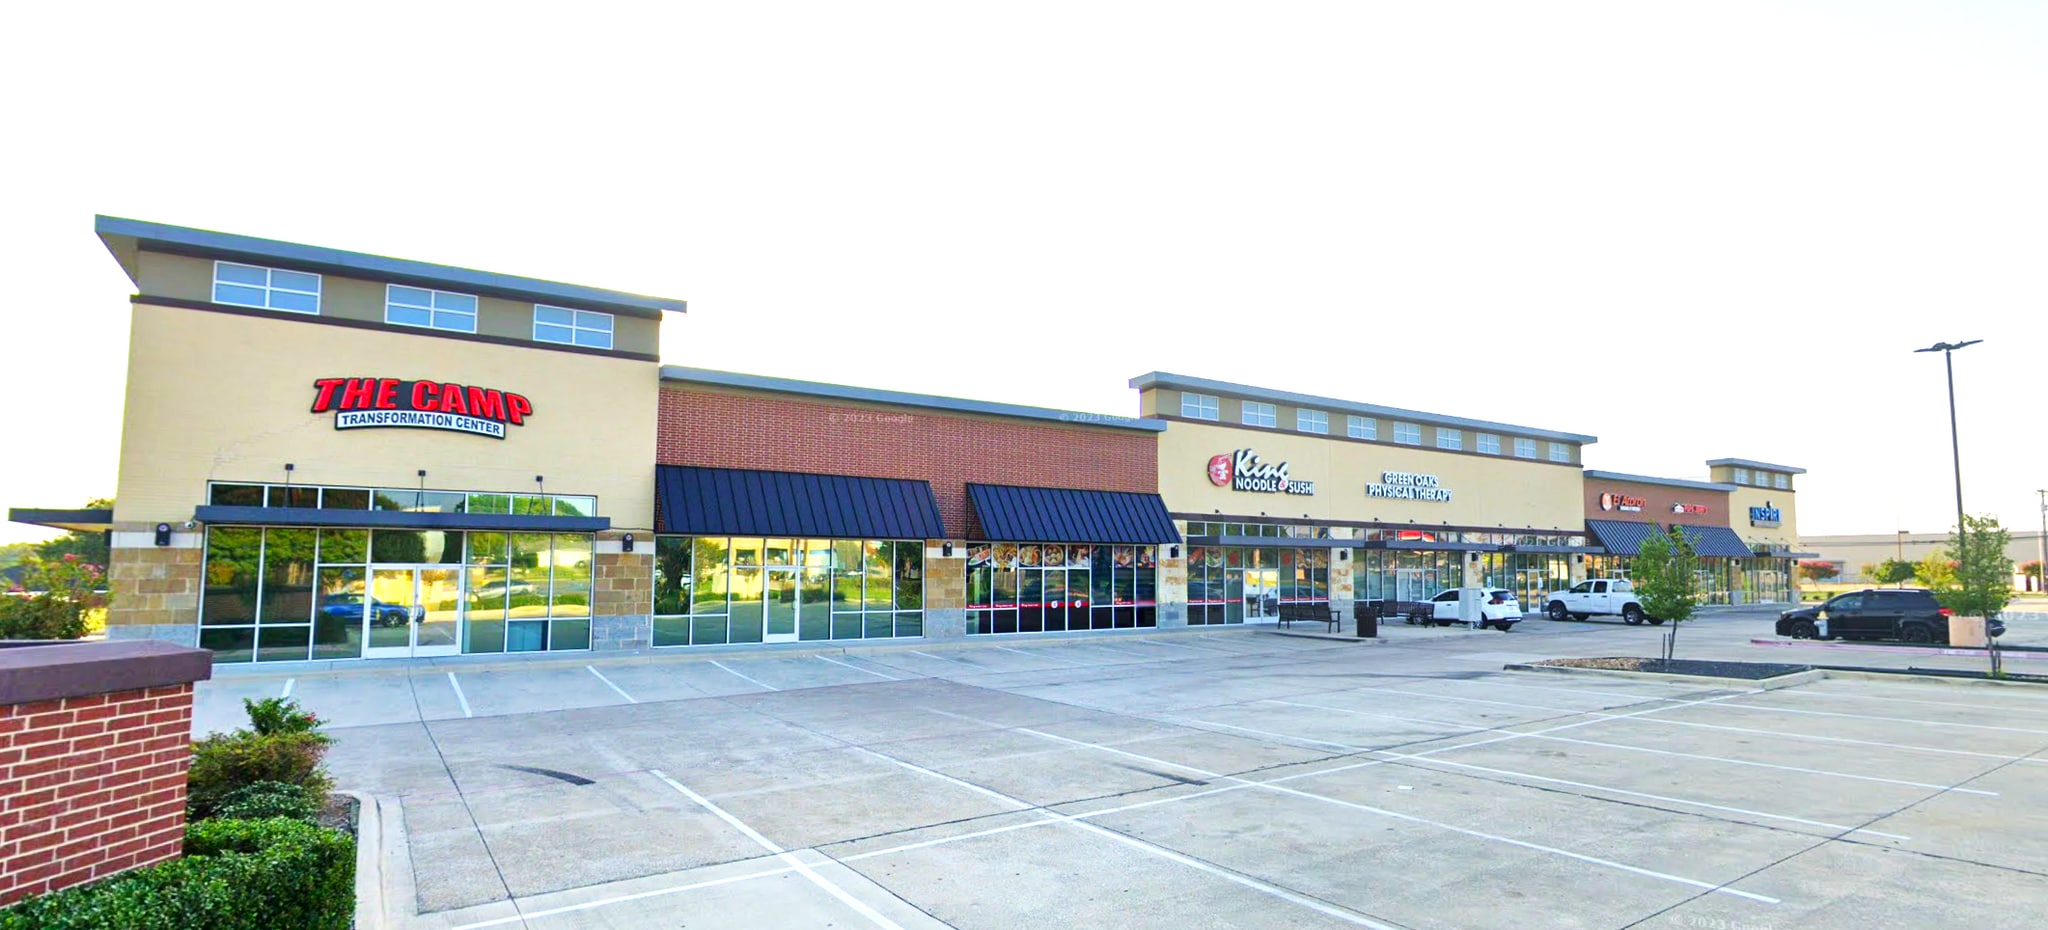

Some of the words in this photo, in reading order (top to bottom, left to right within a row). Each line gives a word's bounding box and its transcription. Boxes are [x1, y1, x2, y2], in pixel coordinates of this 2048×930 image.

[311, 378, 400, 412] THE
[411, 380, 533, 425] CAMP
[342, 412, 455, 428] TRANSFORMATION
[456, 418, 500, 435] CENTER
[1234, 449, 1289, 490] King
[1384, 472, 1414, 486] GREEN
[1415, 474, 1439, 487] OAKS
[1236, 477, 1277, 492] NOODLE
[1288, 481, 1315, 494] SUSHI
[1369, 484, 1414, 499] PHYSICAL
[1415, 487, 1452, 502] THERAPY
